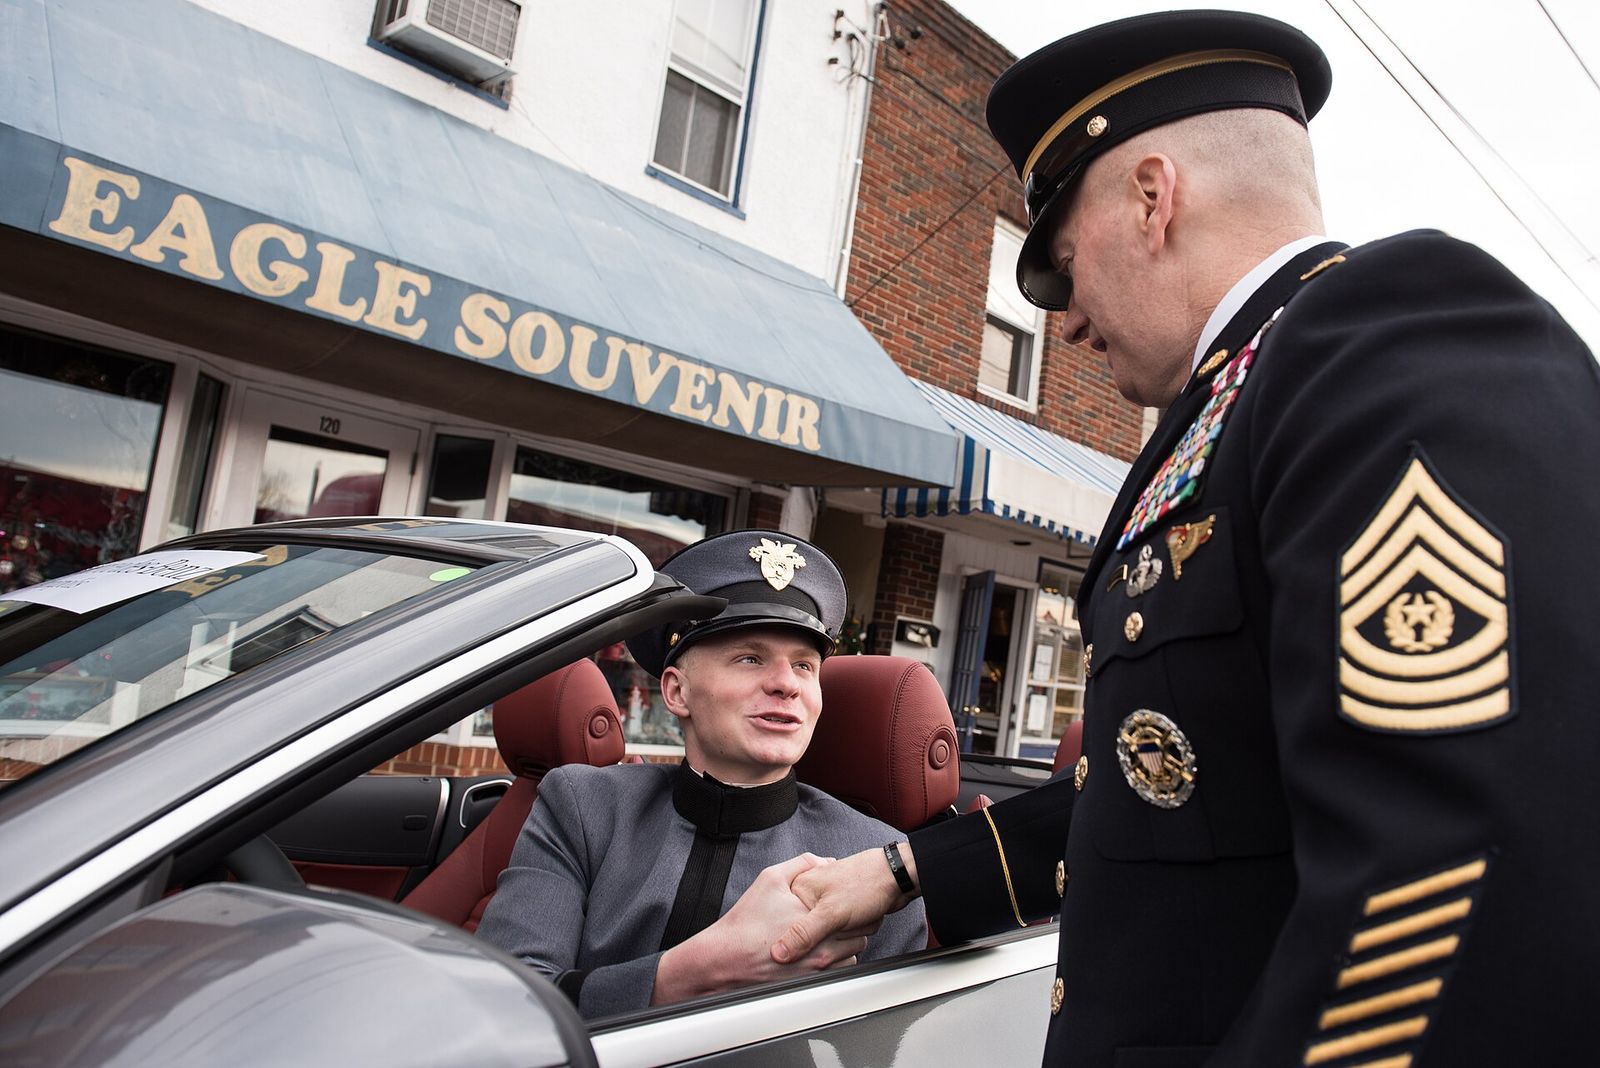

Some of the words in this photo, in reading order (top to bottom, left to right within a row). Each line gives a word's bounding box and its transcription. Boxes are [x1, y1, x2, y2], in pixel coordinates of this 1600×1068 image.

[48, 156, 432, 341] EAGLE
[454, 293, 822, 451] SOUVENIR
[319, 415, 341, 435] 120
